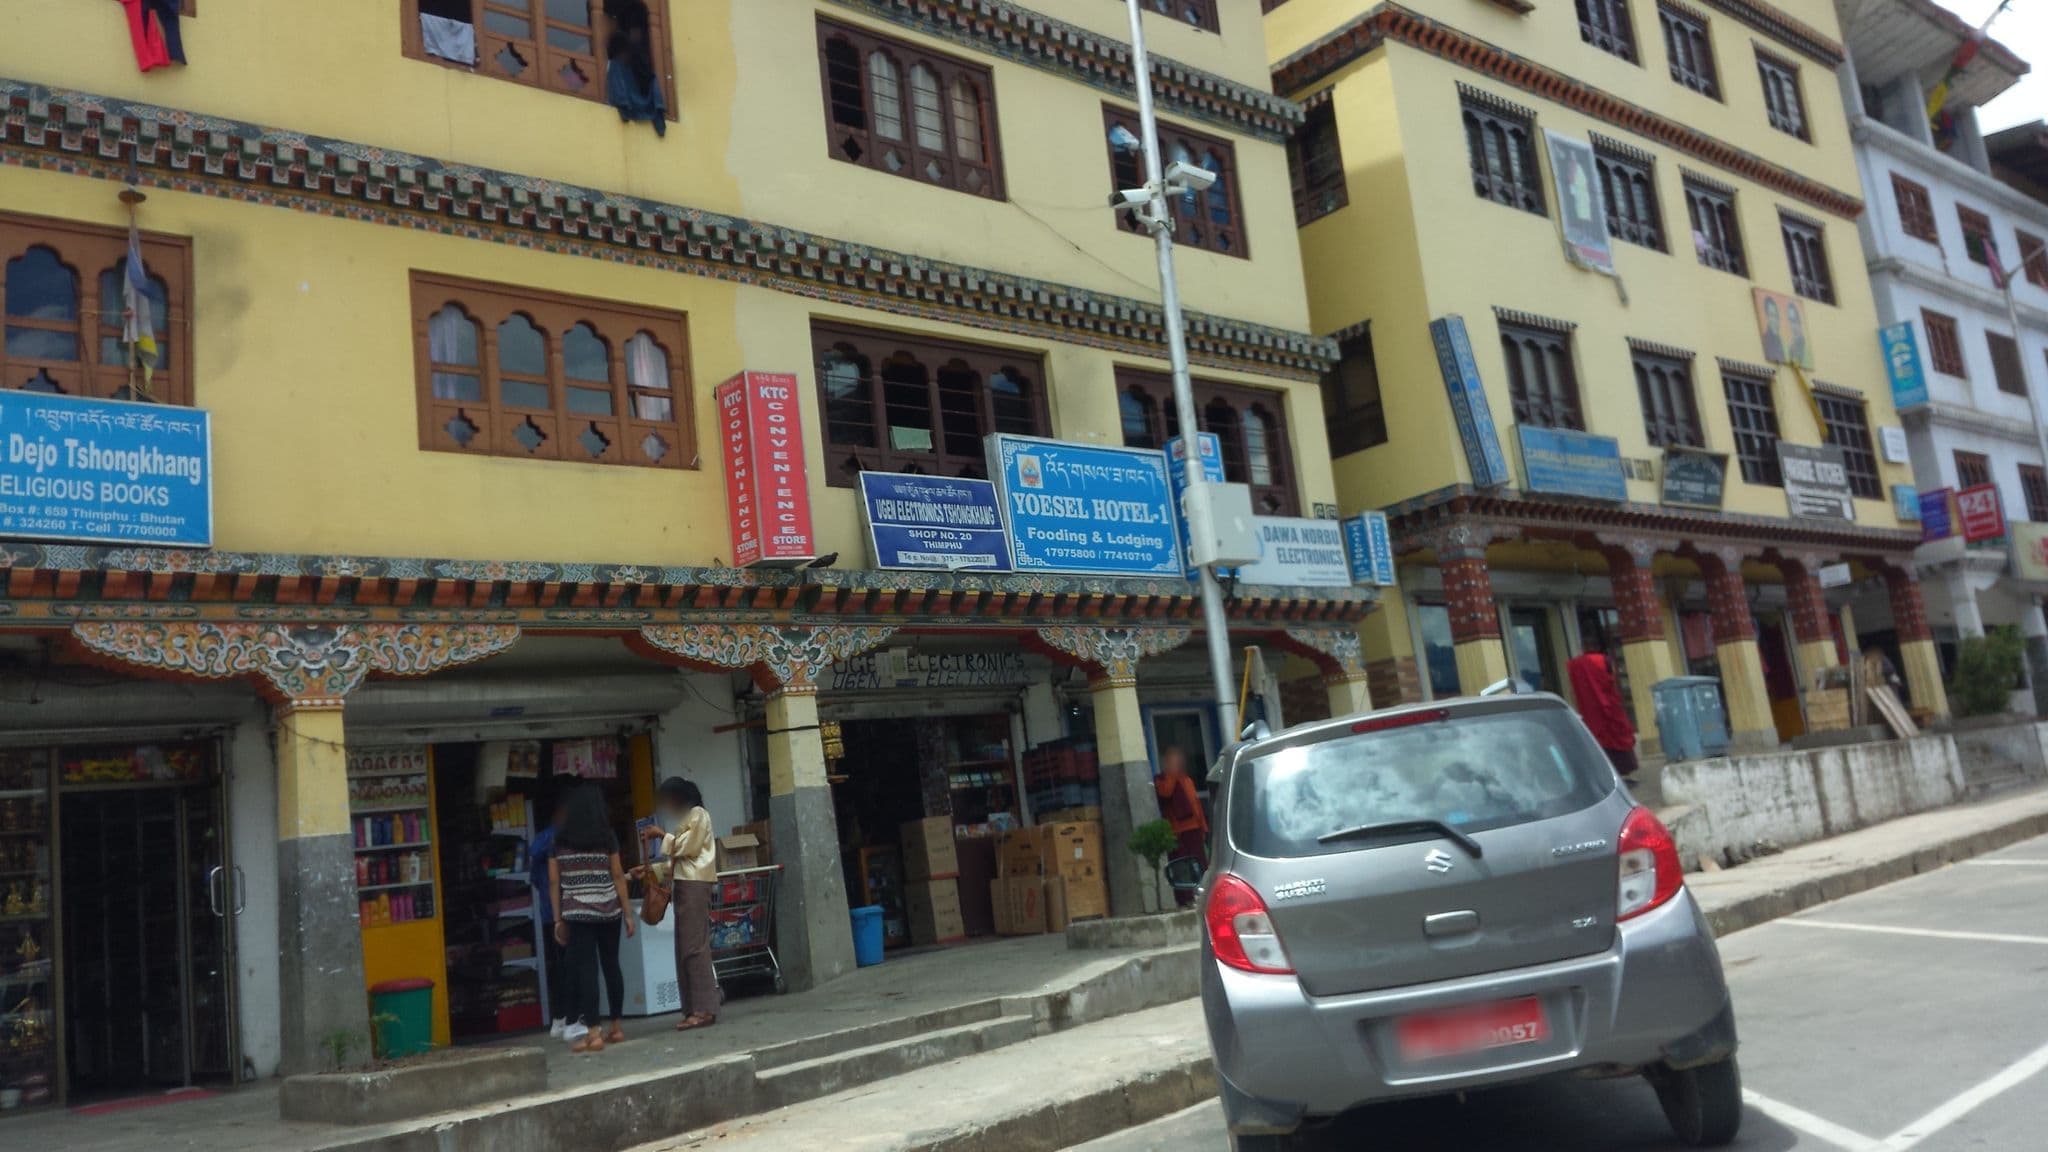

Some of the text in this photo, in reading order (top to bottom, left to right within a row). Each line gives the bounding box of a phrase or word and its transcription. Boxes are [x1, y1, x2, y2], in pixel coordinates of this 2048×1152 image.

[723, 390, 742, 409] KTC
[759, 386, 789, 400] KTC
[9, 432, 201, 485] Dejo Tshongkhang
[729, 407, 751, 541] CONVENIENCE
[767, 402, 796, 534] CONVENIENCE
[101, 482, 169, 507] BOOKS
[72, 508, 129, 522] Thimphu
[140, 512, 185, 525] Bhutan
[875, 499, 995, 526] UGEN ELECTRONICS TSHONGKHANG
[1012, 492, 1169, 524] YOESEL HOTEL-1
[772, 535, 807, 545] STORE
[908, 529, 973, 541] SHOP NO. 20
[1027, 527, 1163, 549] Fooding & Lodging
[1262, 526, 1341, 545] DAWA NORBU
[736, 539, 758, 554] STORE
[922, 541, 963, 550] THIMPHU
[1276, 547, 1345, 565] ELECTRONICS
[832, 653, 1025, 673] UGE ELECTRONICS
[832, 672, 881, 689] UGEN
[1273, 878, 1325, 893] MARUTI
[1275, 884, 1327, 901] SUZUKI
